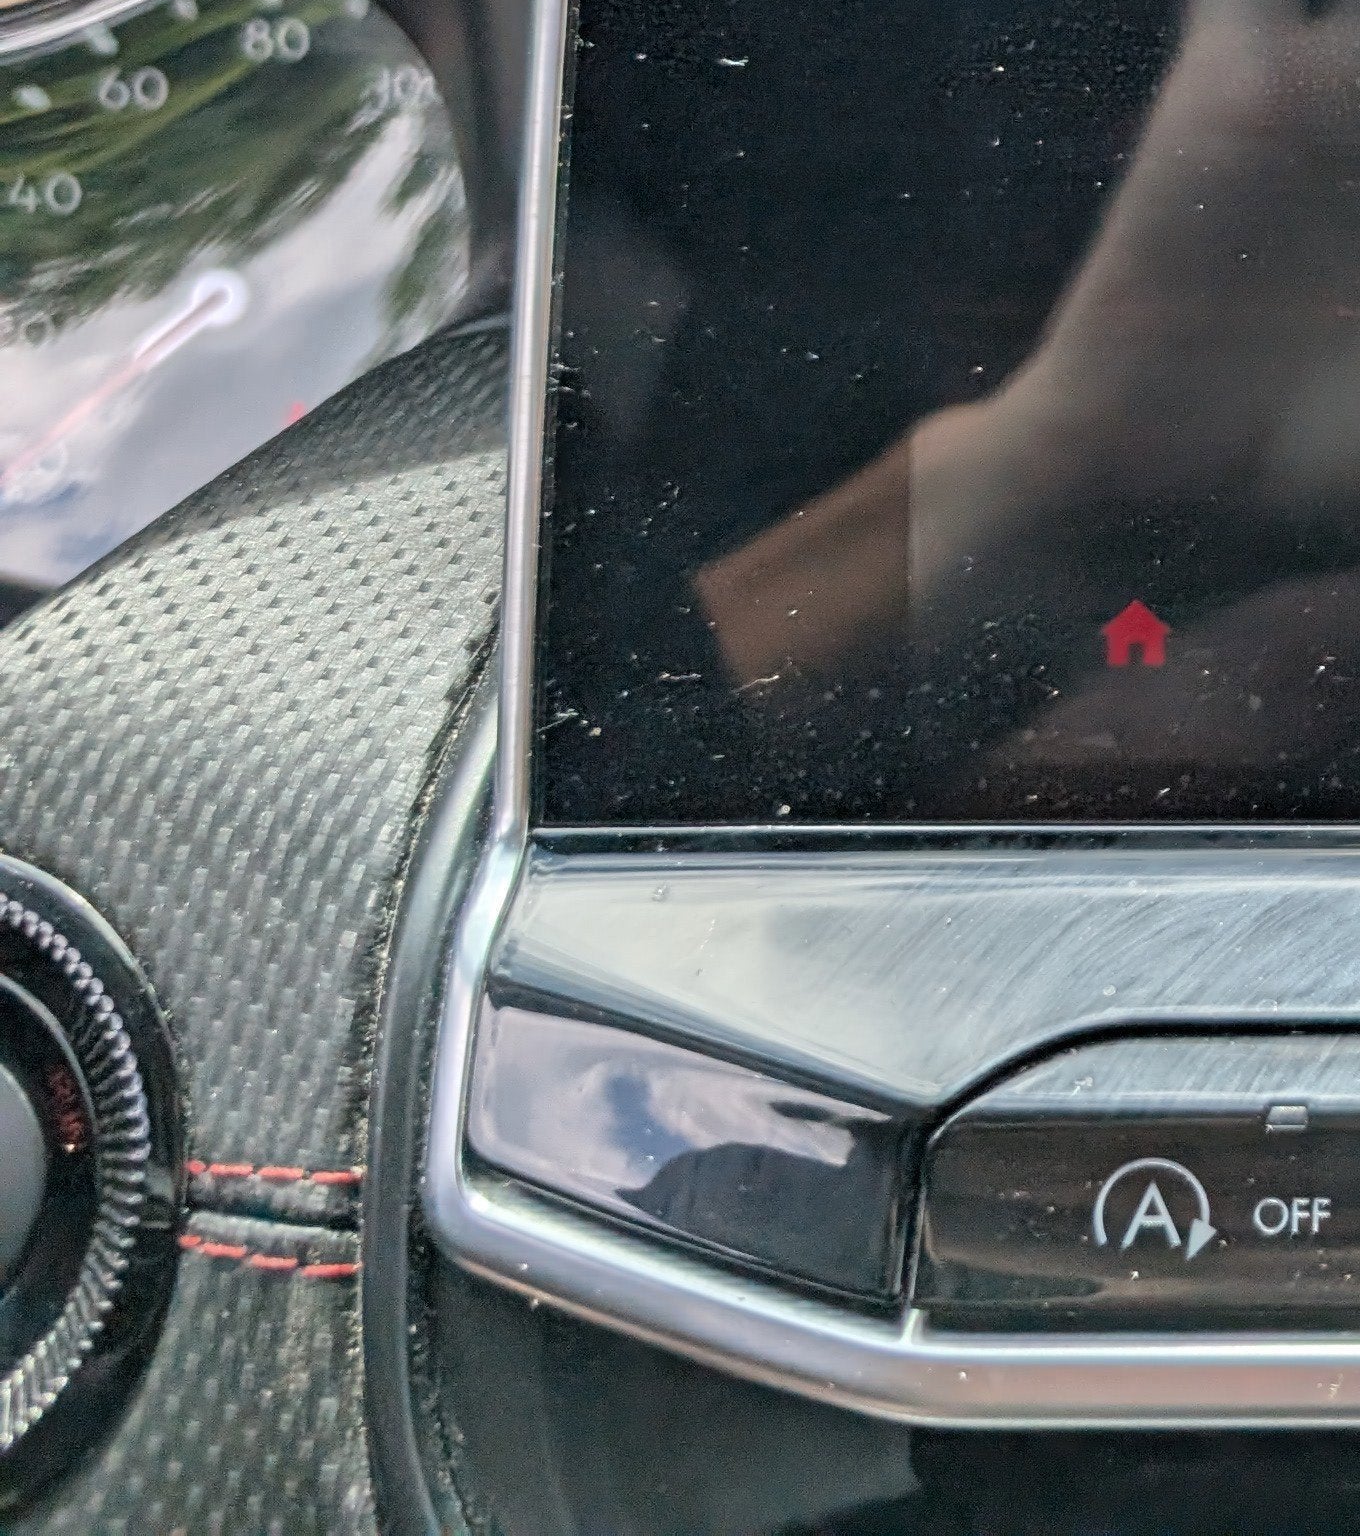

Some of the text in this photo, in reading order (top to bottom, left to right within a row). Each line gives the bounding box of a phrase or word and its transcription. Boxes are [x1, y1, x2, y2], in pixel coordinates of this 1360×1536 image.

[240, 16, 311, 61] 80
[99, 66, 169, 111] 60
[8, 170, 83, 215] 40
[1252, 1196, 1333, 1239] OFF
